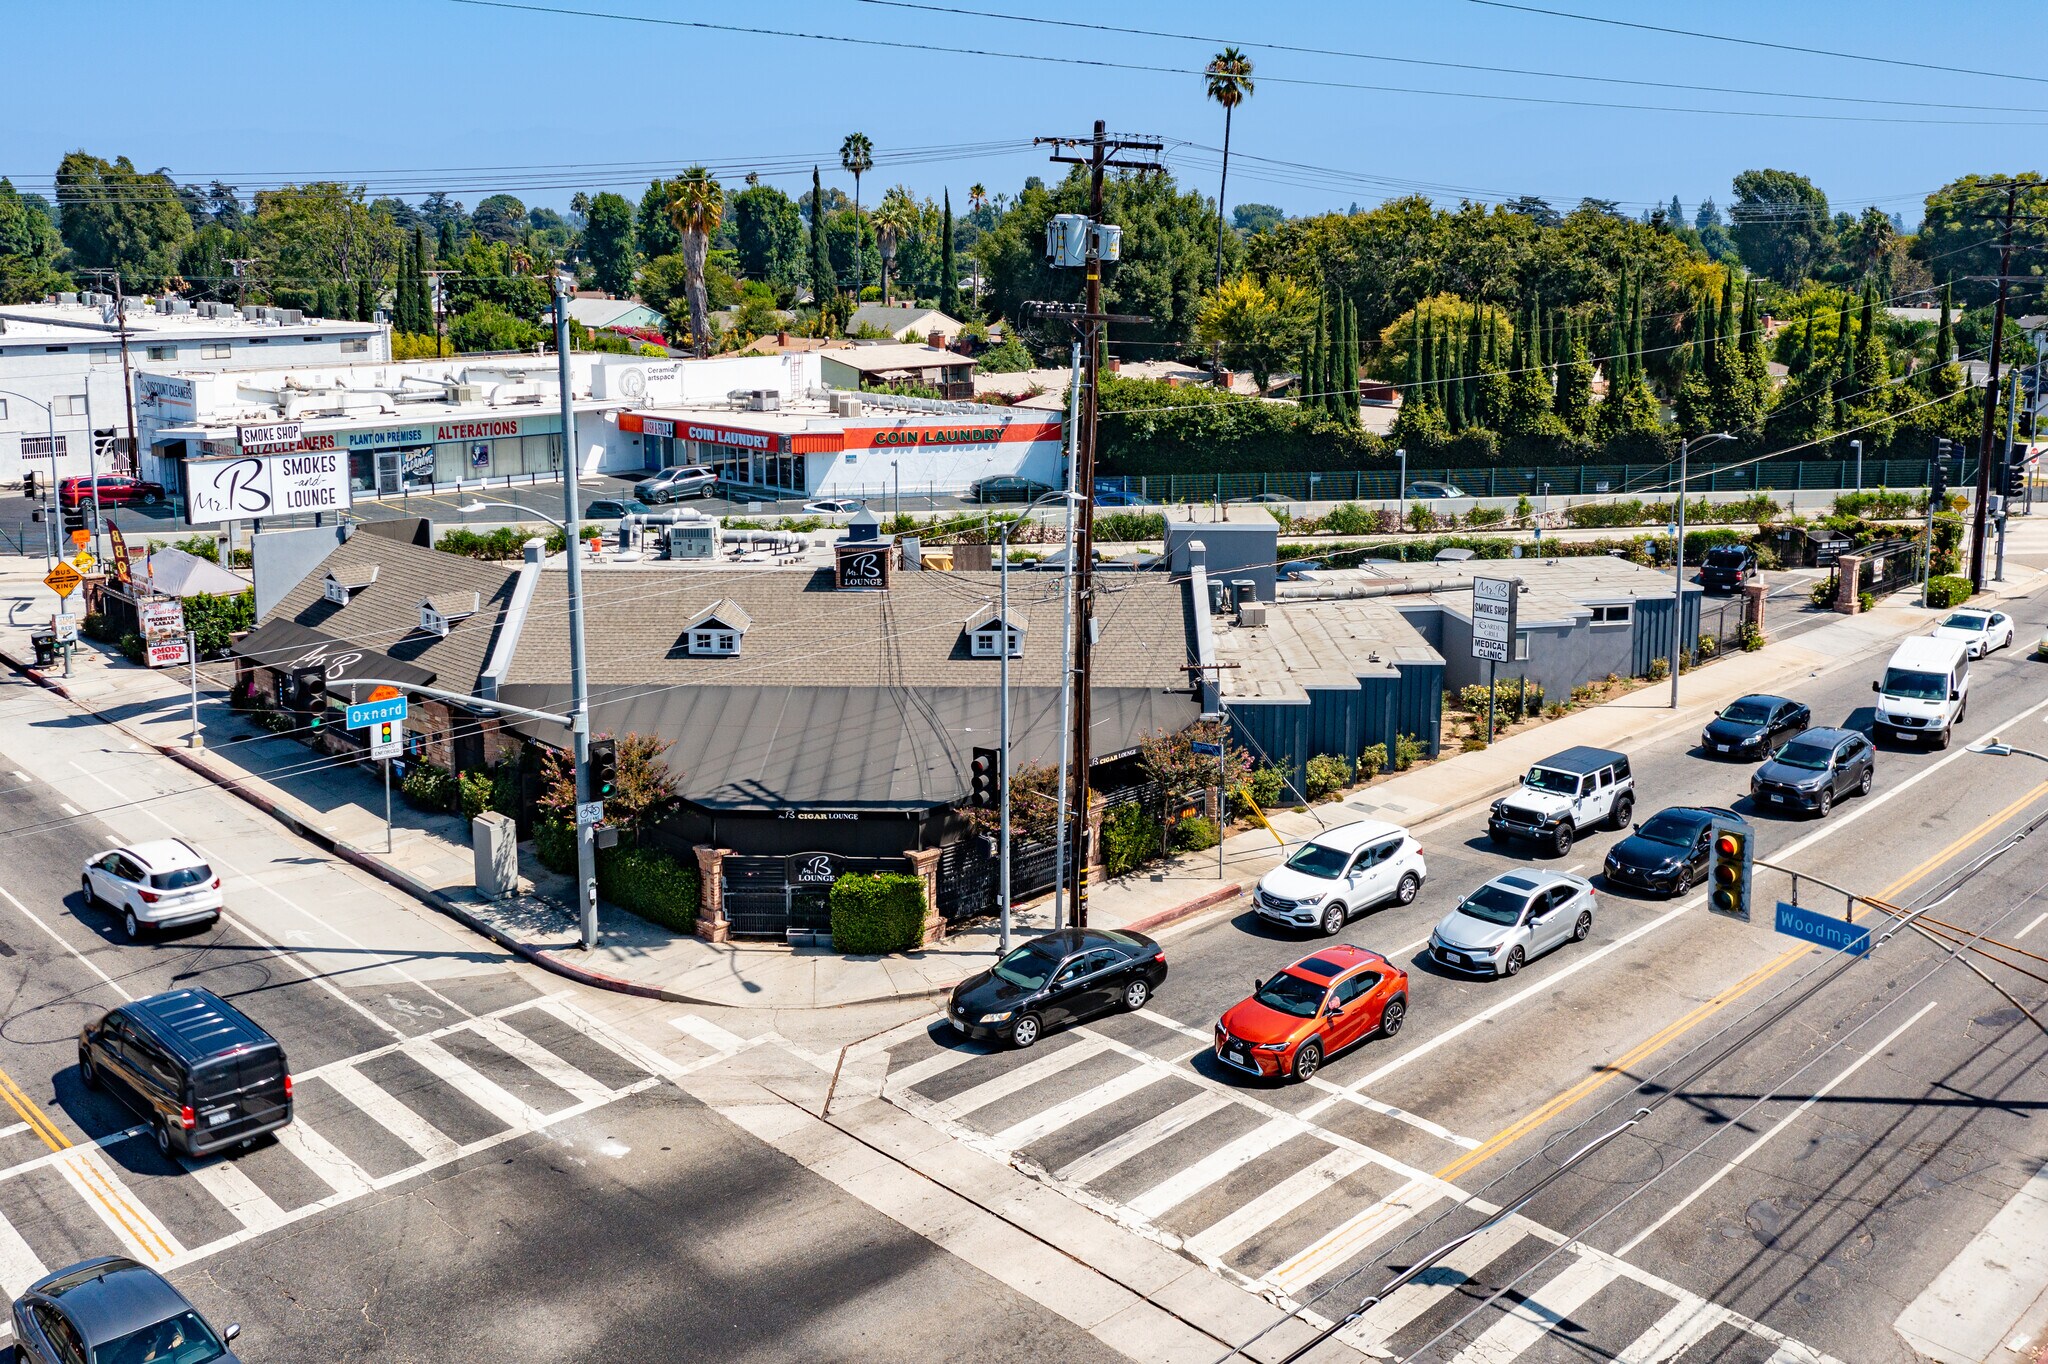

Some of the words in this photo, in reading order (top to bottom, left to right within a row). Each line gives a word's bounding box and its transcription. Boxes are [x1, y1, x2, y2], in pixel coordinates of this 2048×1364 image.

[146, 380, 169, 397] DISCOUNT
[168, 384, 192, 400] CLEANERS
[244, 427, 274, 443] SMOKE
[276, 425, 299, 440] SHOP
[350, 433, 373, 445] PLANT
[374, 432, 385, 444] ON
[387, 429, 422, 443] PREMISES
[437, 420, 517, 440] ALTERATIONS
[688, 426, 715, 443] COIN
[717, 430, 770, 449] LAUNDRY
[875, 431, 918, 444] COIN
[925, 428, 1005, 443] LAUNDRY
[273, 434, 335, 453] CLEANERS
[405, 446, 431, 461] DRY
[283, 455, 336, 476] SMOKES
[402, 454, 434, 474] CLEANING
[192, 492, 228, 516] Mr.
[213, 458, 271, 512] B
[287, 487, 336, 508] LOUNGE
[852, 554, 880, 578] B
[55, 582, 74, 590] XING
[844, 578, 883, 586] LOUNGE
[1494, 582, 1508, 598] B
[1474, 602, 1493, 614] SMOKE
[1494, 605, 1508, 616] SHOP
[151, 645, 185, 656] SMOKE
[1474, 638, 1506, 652] MEDICAL
[156, 653, 181, 662] SHOP
[1478, 648, 1502, 660] CLINIC
[324, 652, 363, 680] B
[352, 703, 402, 723] Oxnard
[374, 748, 400, 756] ENFORCED
[1099, 754, 1119, 765] CIGAR
[1118, 749, 1137, 759] LOUNGE
[808, 855, 832, 876] B
[798, 874, 836, 882] LOUNGE
[1781, 911, 1865, 950] Woodman
